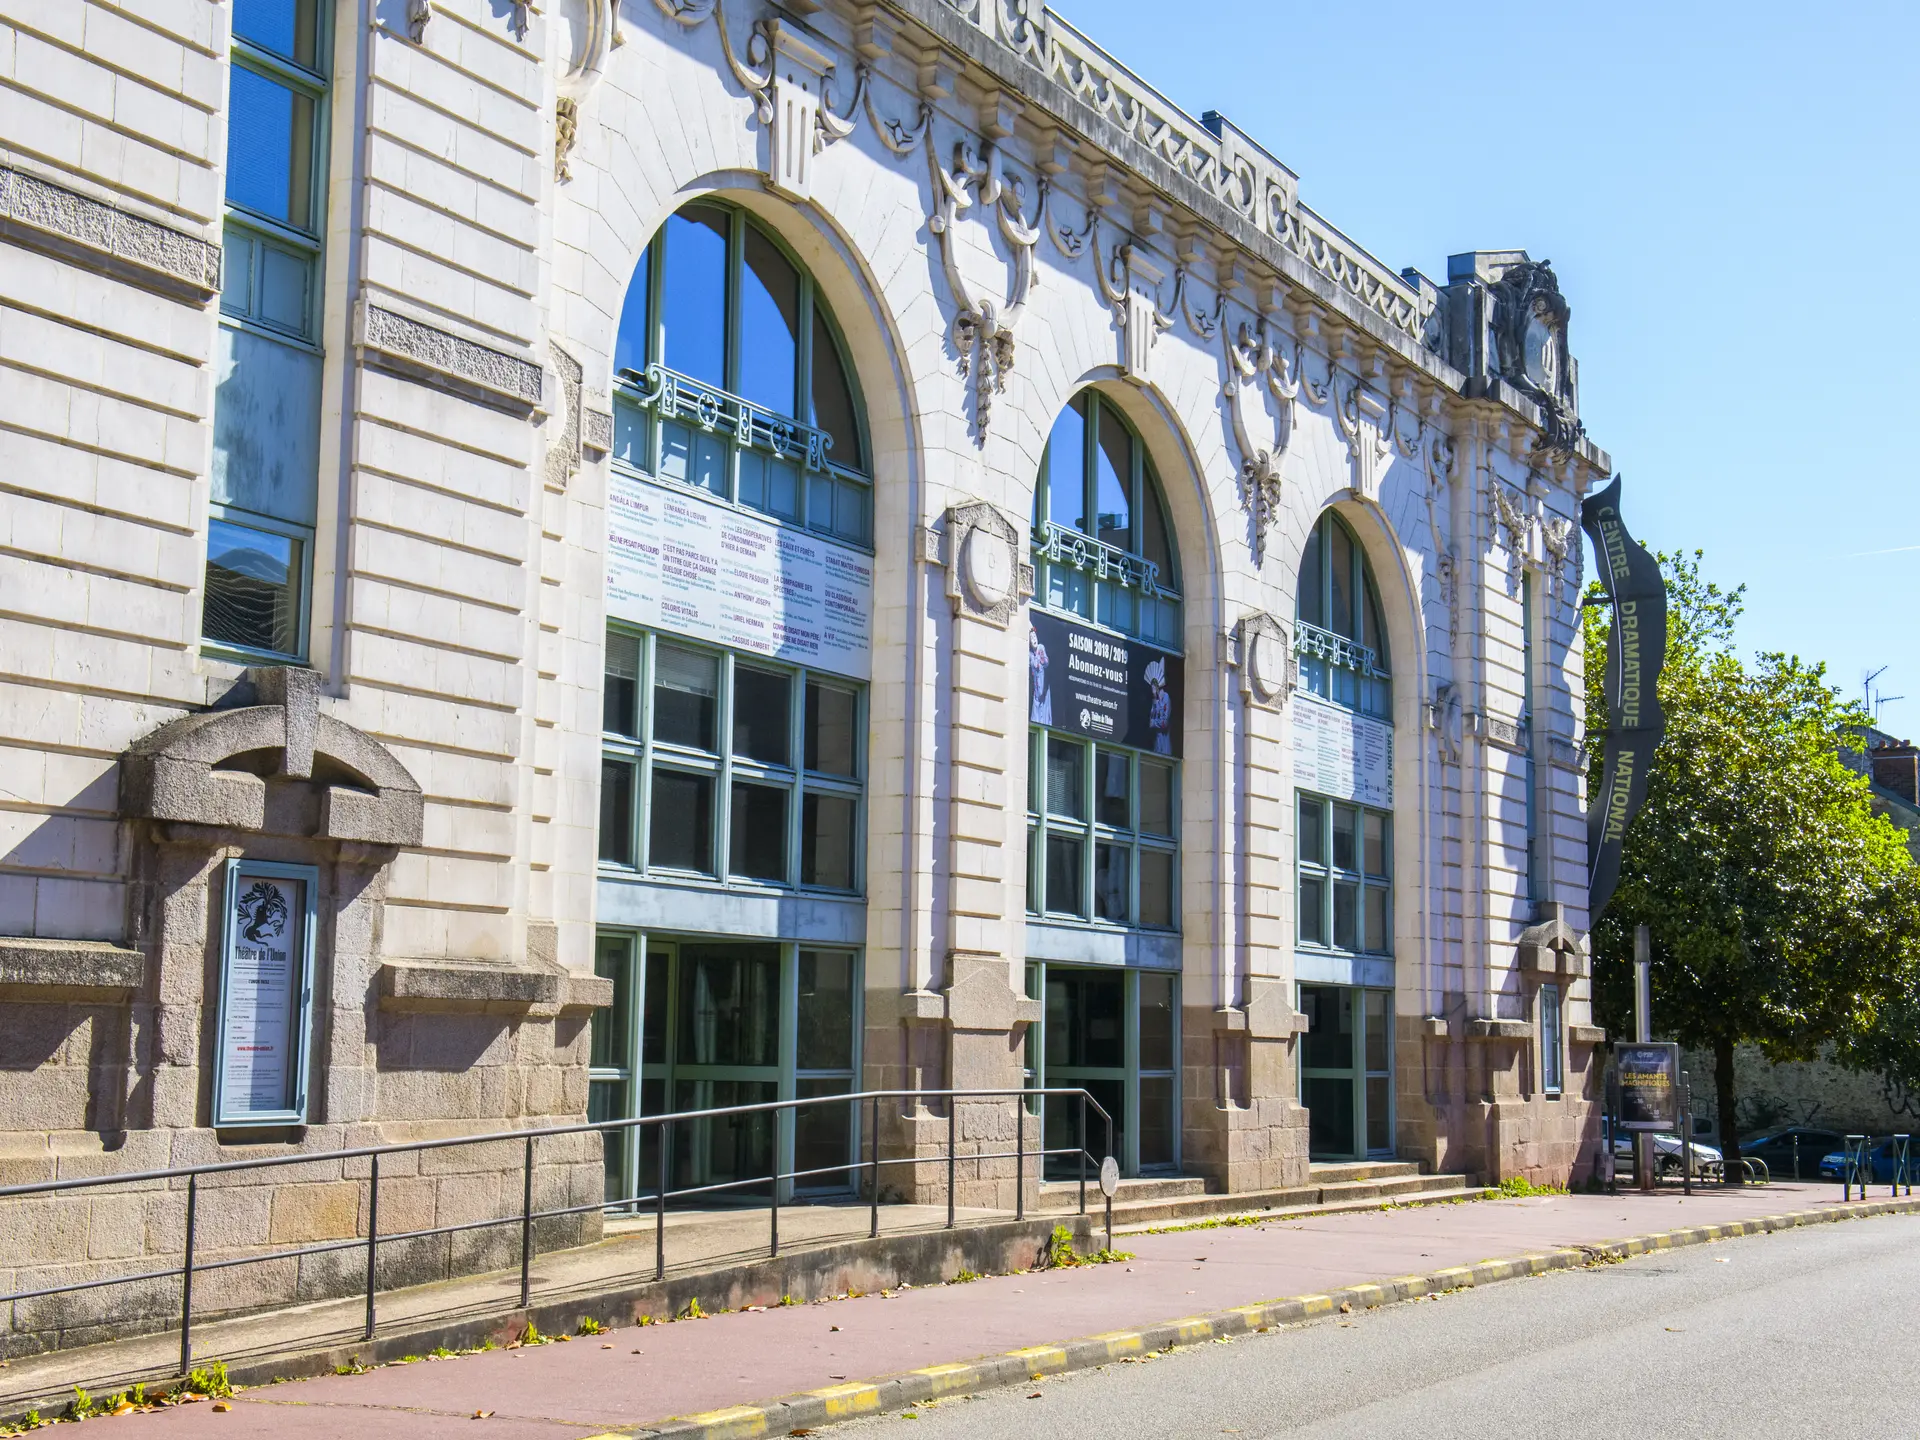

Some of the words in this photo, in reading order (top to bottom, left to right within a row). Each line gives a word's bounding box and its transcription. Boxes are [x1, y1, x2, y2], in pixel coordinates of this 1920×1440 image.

[721, 541, 735, 551] D'HIER
[740, 547, 757, 558] DEMAIN
[728, 533, 766, 551] CONSOMMATEURS
[1599, 506, 1630, 580] CENTRE
[663, 544, 675, 553] C'EST
[676, 548, 684, 556] PAS
[685, 550, 699, 560] PARCE
[662, 564, 682, 576] QUELQUE
[683, 570, 697, 580] CHOSE
[663, 554, 669, 562] UN
[670, 556, 682, 566] TITRE
[683, 560, 692, 568] QUE
[699, 565, 716, 576] CHANGE
[749, 573, 769, 585] PASQUIER
[780, 577, 804, 590] COMPAGNIE
[734, 591, 754, 602] ANTHONY
[755, 597, 771, 607] JOSEPH
[661, 602, 681, 613] COLORIS
[681, 607, 698, 618] VITALIS
[746, 618, 764, 629] HERMAN
[732, 635, 750, 645] CASSIUS
[750, 639, 770, 650] LAMBERT
[1069, 632, 1093, 653] SAISON
[1094, 640, 1109, 659] 2018
[1113, 646, 1129, 664] 2019
[1069, 653, 1123, 683] Abonnez-vous
[1621, 600, 1641, 727] DRAMATIQUE
[1604, 751, 1635, 843] NATIONAL
[235, 946, 257, 960] Théâtre
[259, 947, 265, 960] de
